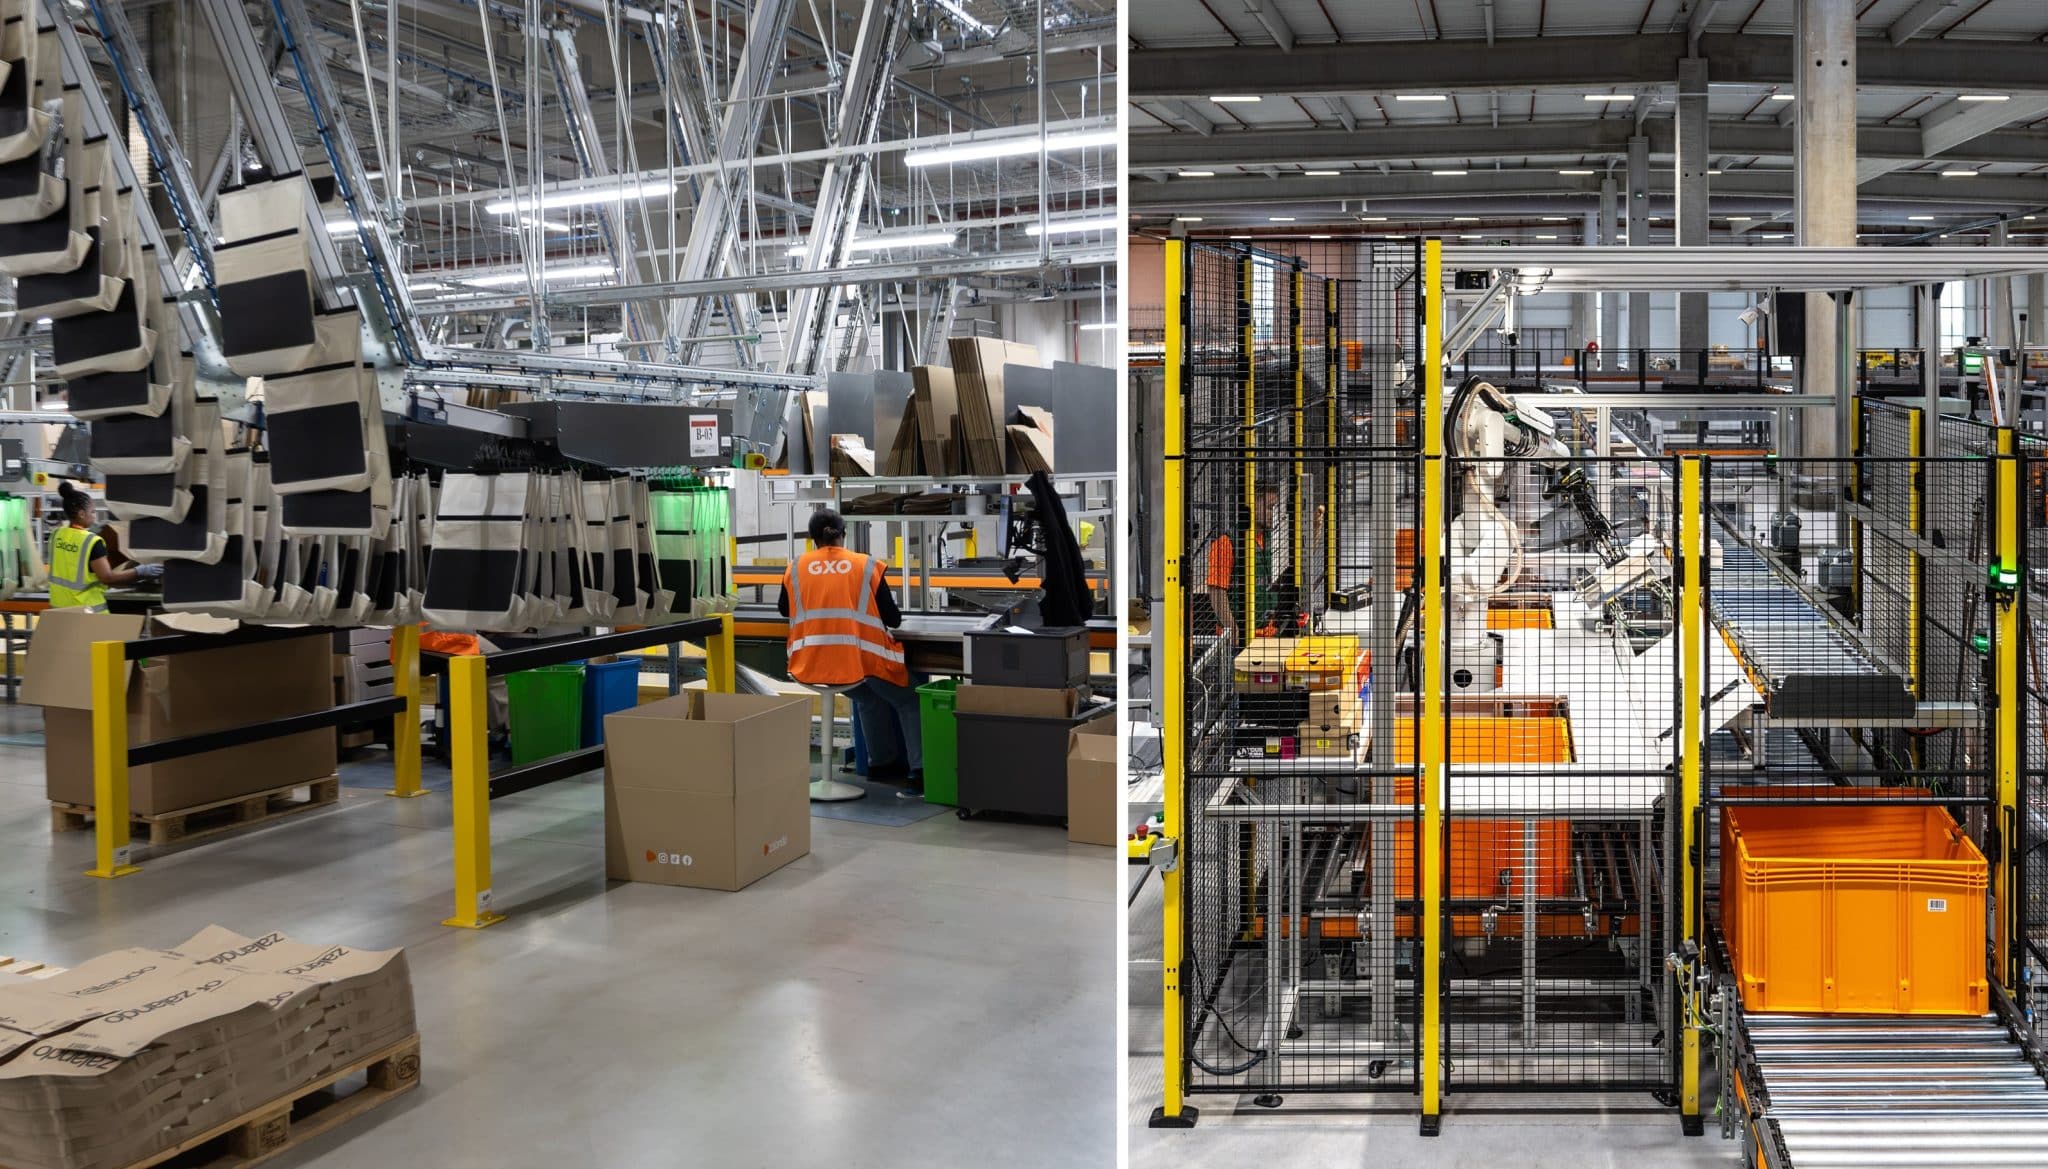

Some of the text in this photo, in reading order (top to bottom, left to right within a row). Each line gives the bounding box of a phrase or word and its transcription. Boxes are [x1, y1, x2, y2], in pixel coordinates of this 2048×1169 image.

[696, 428, 713, 441] B-03
[808, 560, 852, 575] GXO
[104, 989, 197, 1024] zalando
[33, 1045, 119, 1070] zalando
